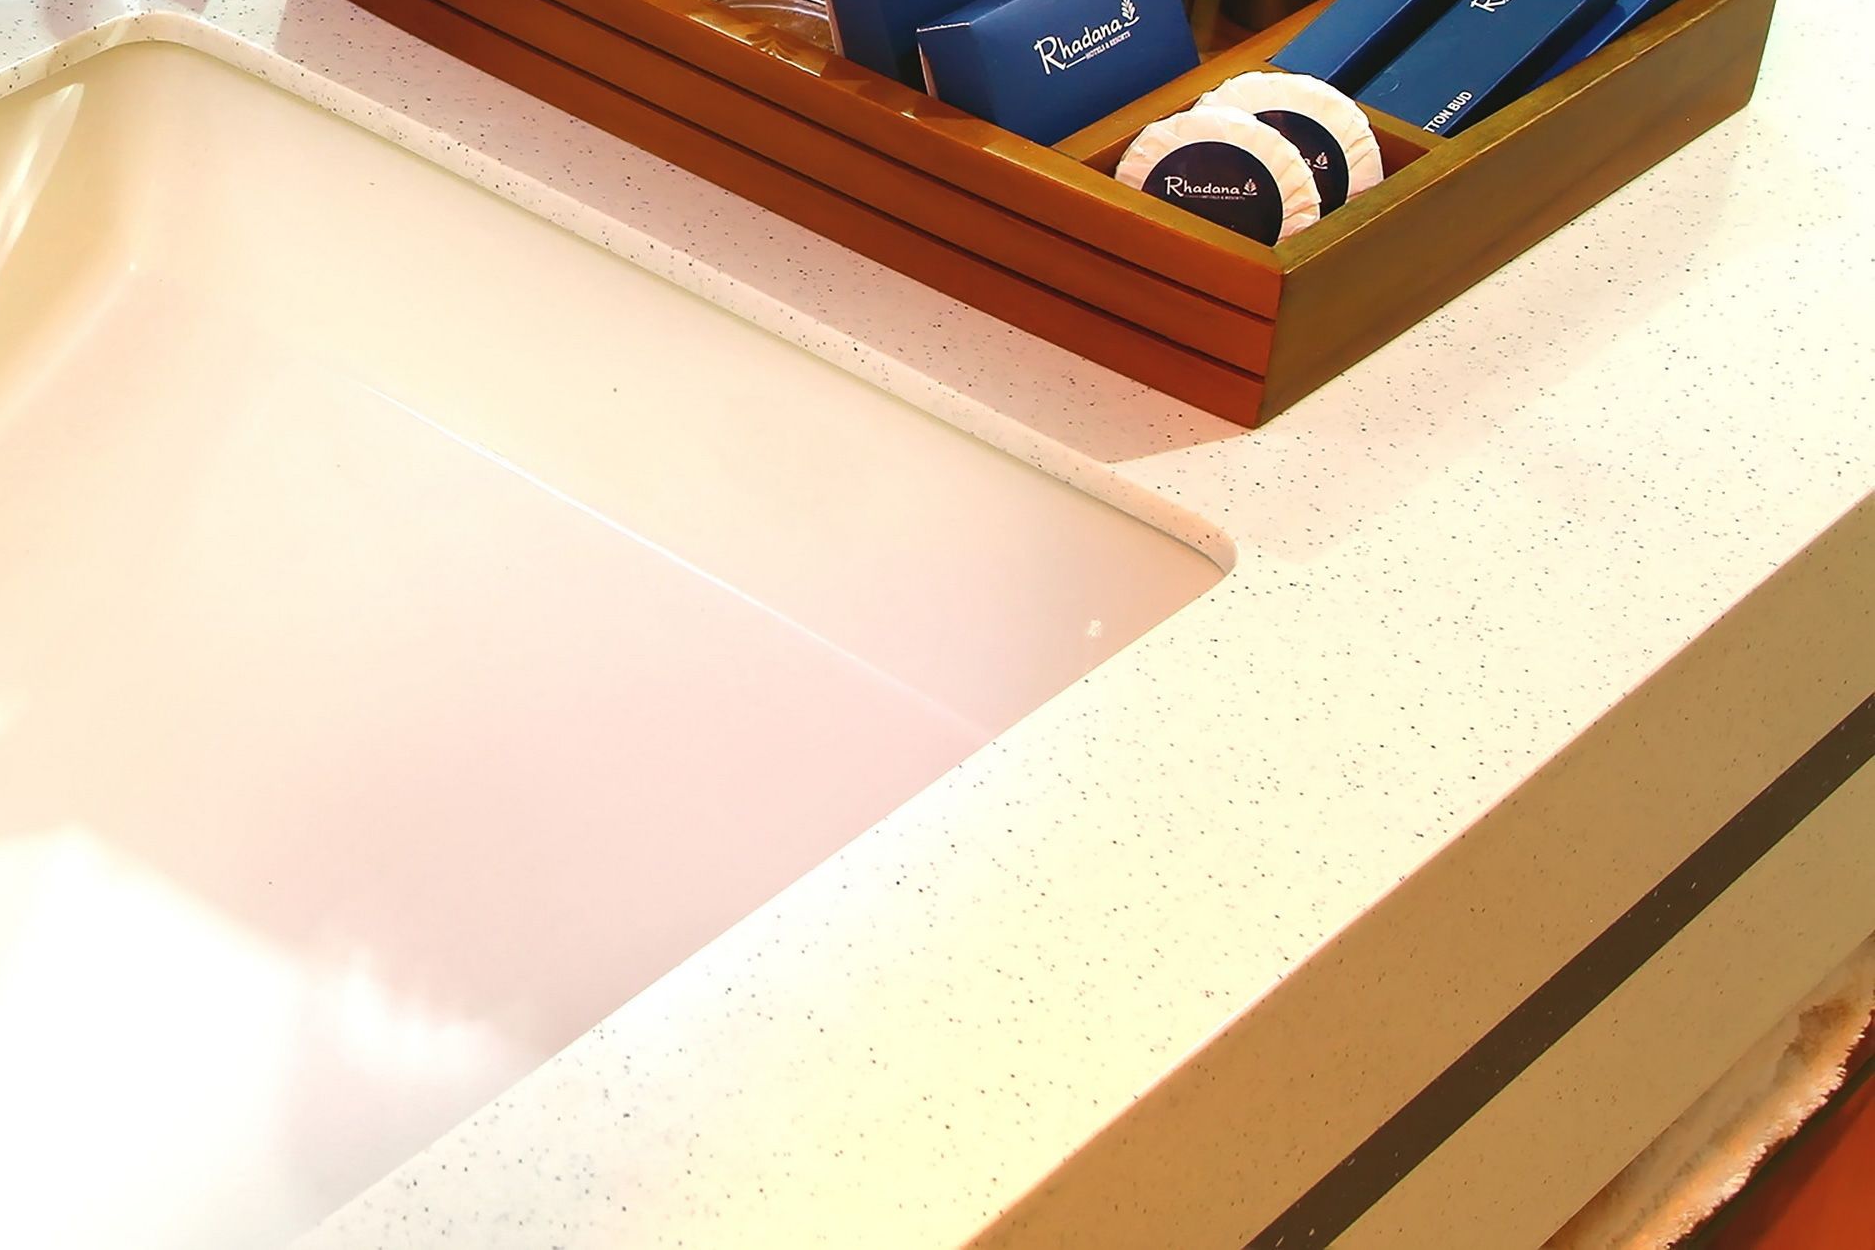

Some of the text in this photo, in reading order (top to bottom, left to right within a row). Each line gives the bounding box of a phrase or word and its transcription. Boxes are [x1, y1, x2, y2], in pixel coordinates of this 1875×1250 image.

[1034, 17, 1122, 75] Rhadana
[1447, 91, 1473, 111] BUD
[1164, 176, 1240, 198] Rhadana
